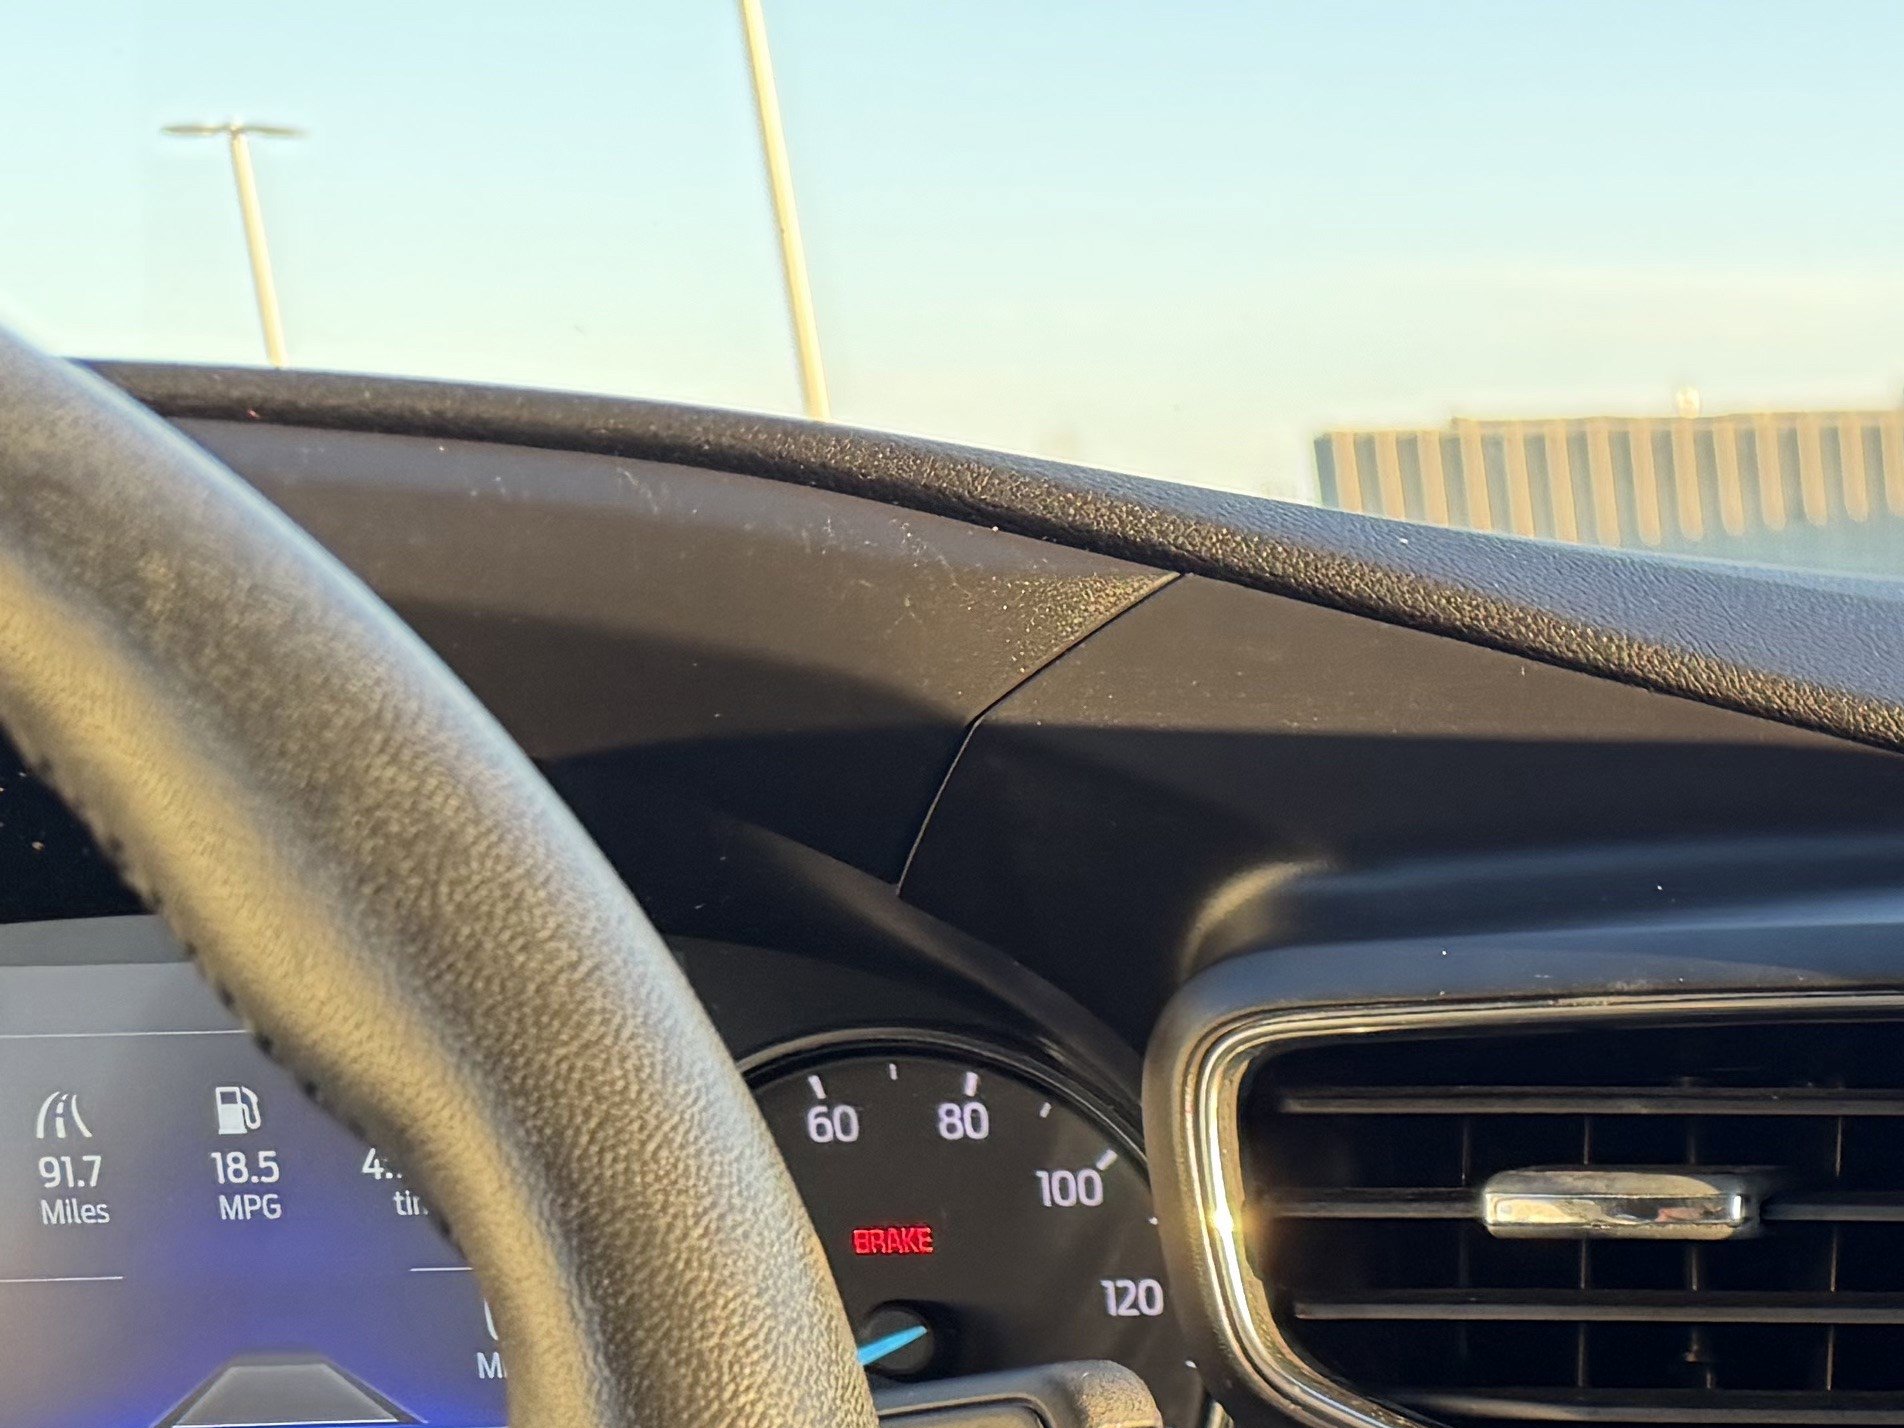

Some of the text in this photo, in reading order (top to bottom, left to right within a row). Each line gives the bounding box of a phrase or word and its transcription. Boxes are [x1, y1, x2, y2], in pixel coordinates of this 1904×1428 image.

[807, 1105, 859, 1143] 60
[938, 1101, 989, 1140] 80
[38, 1155, 102, 1188] 91.7
[211, 1150, 280, 1184] 18.5
[1035, 1168, 1103, 1208] 100
[41, 1199, 110, 1225] Miles
[219, 1194, 282, 1221] MPG
[853, 1226, 934, 1255] BRAKE
[1099, 1278, 1164, 1318] 120
